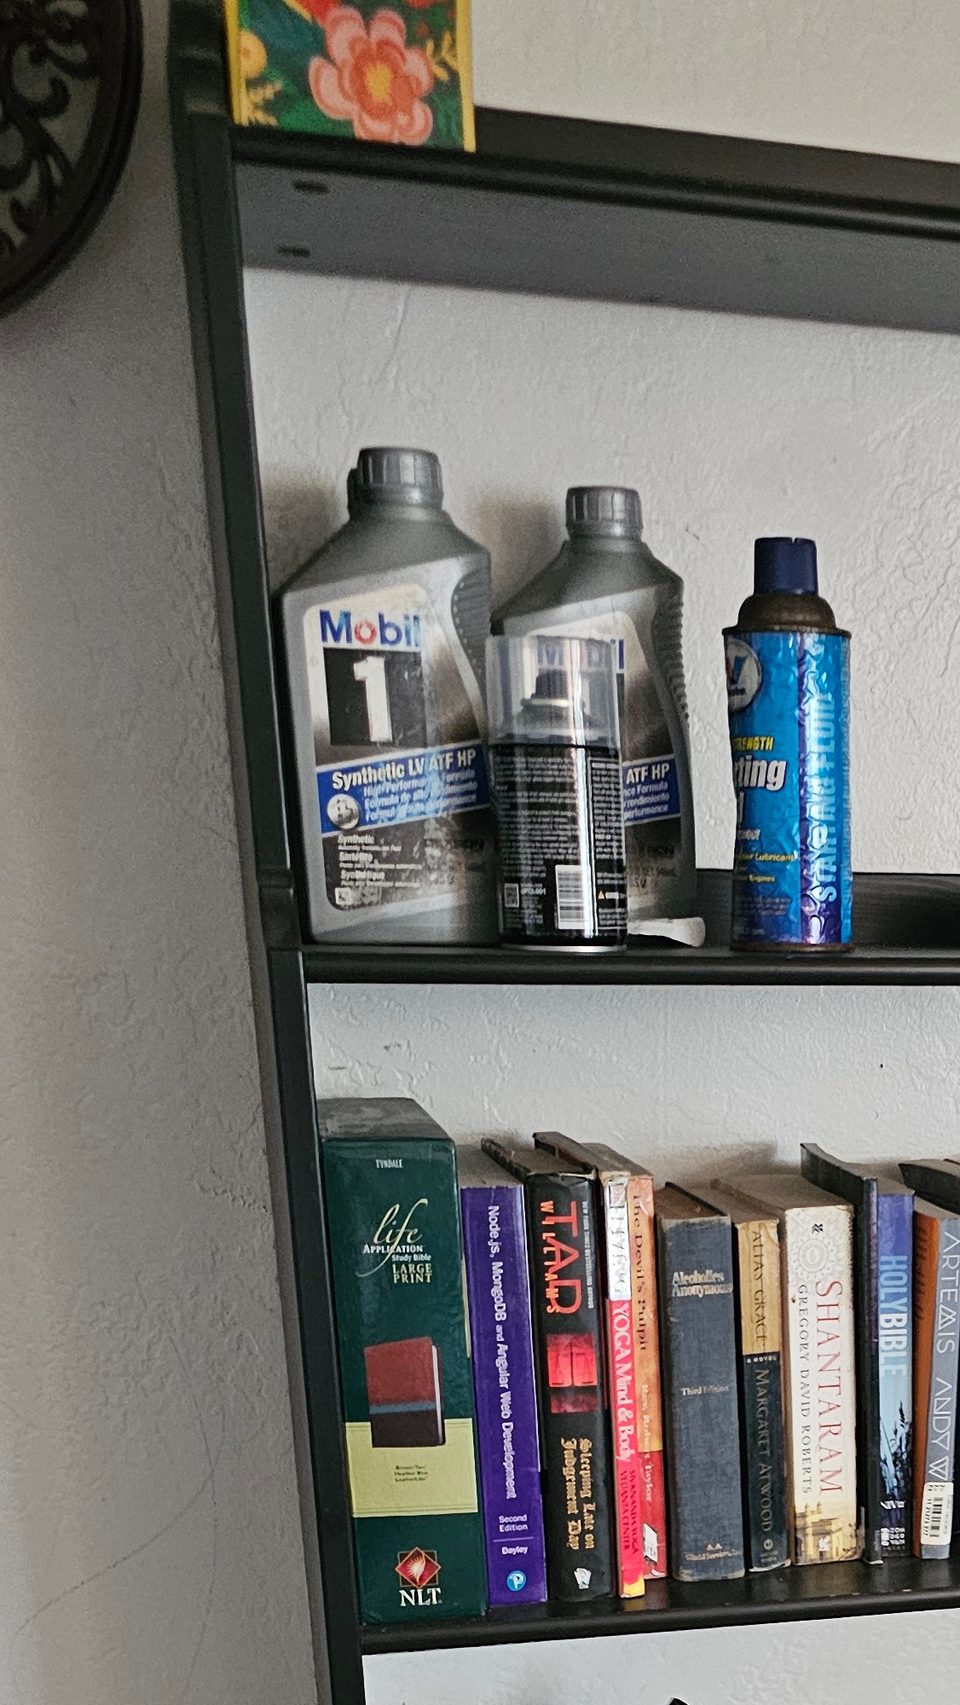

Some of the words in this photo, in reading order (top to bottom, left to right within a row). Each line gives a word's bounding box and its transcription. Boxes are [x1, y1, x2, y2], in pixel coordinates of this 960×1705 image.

[319, 609, 421, 647] Mobil
[353, 655, 393, 743] 1
[332, 762, 405, 791] Synthetic
[408, 759, 426, 778] LV
[428, 752, 454, 771] ATF
[457, 749, 477, 767] HP
[626, 765, 648, 783] ATF
[652, 763, 670, 781] HP
[375, 1158, 403, 1169] TYNDALE
[355, 1198, 429, 1278] life
[487, 1205, 500, 1258] Node.js,
[391, 1253, 412, 1263] Study
[413, 1253, 432, 1262] Bible
[392, 1262, 433, 1274] LARGE
[393, 1273, 433, 1284] PRINT
[540, 1200, 559, 1314] WILLIAMS
[549, 1200, 583, 1315] TAD
[633, 1234, 643, 1293] Devil's
[671, 1269, 725, 1286] Alcoholics
[752, 1230, 765, 1282] ALIAS
[490, 1261, 508, 1322] MongoDB
[936, 1231, 960, 1354] ARTEMIS
[495, 1324, 505, 1342] and
[611, 1302, 631, 1362] YOGA
[754, 1288, 768, 1344] GRACE
[797, 1283, 809, 1361] GREGORY
[495, 1342, 511, 1389] Angular
[614, 1363, 633, 1405] Mind
[815, 1279, 844, 1494] SHANTARAM
[500, 1390, 512, 1419] Web
[680, 1386, 702, 1397] Third
[754, 1368, 772, 1457] MARGARET
[799, 1368, 811, 1418] DAVID
[931, 1376, 953, 1451] ANDY
[617, 1409, 634, 1425] &
[501, 1421, 518, 1500] Development
[615, 1425, 637, 1462] Body
[800, 1424, 813, 1495] ROBERTS
[643, 1461, 654, 1503] Taylor
[758, 1462, 774, 1532] ATWOOD
[498, 1513, 528, 1524] Second
[498, 1523, 529, 1533] Edition
[399, 1587, 442, 1607] NLT
